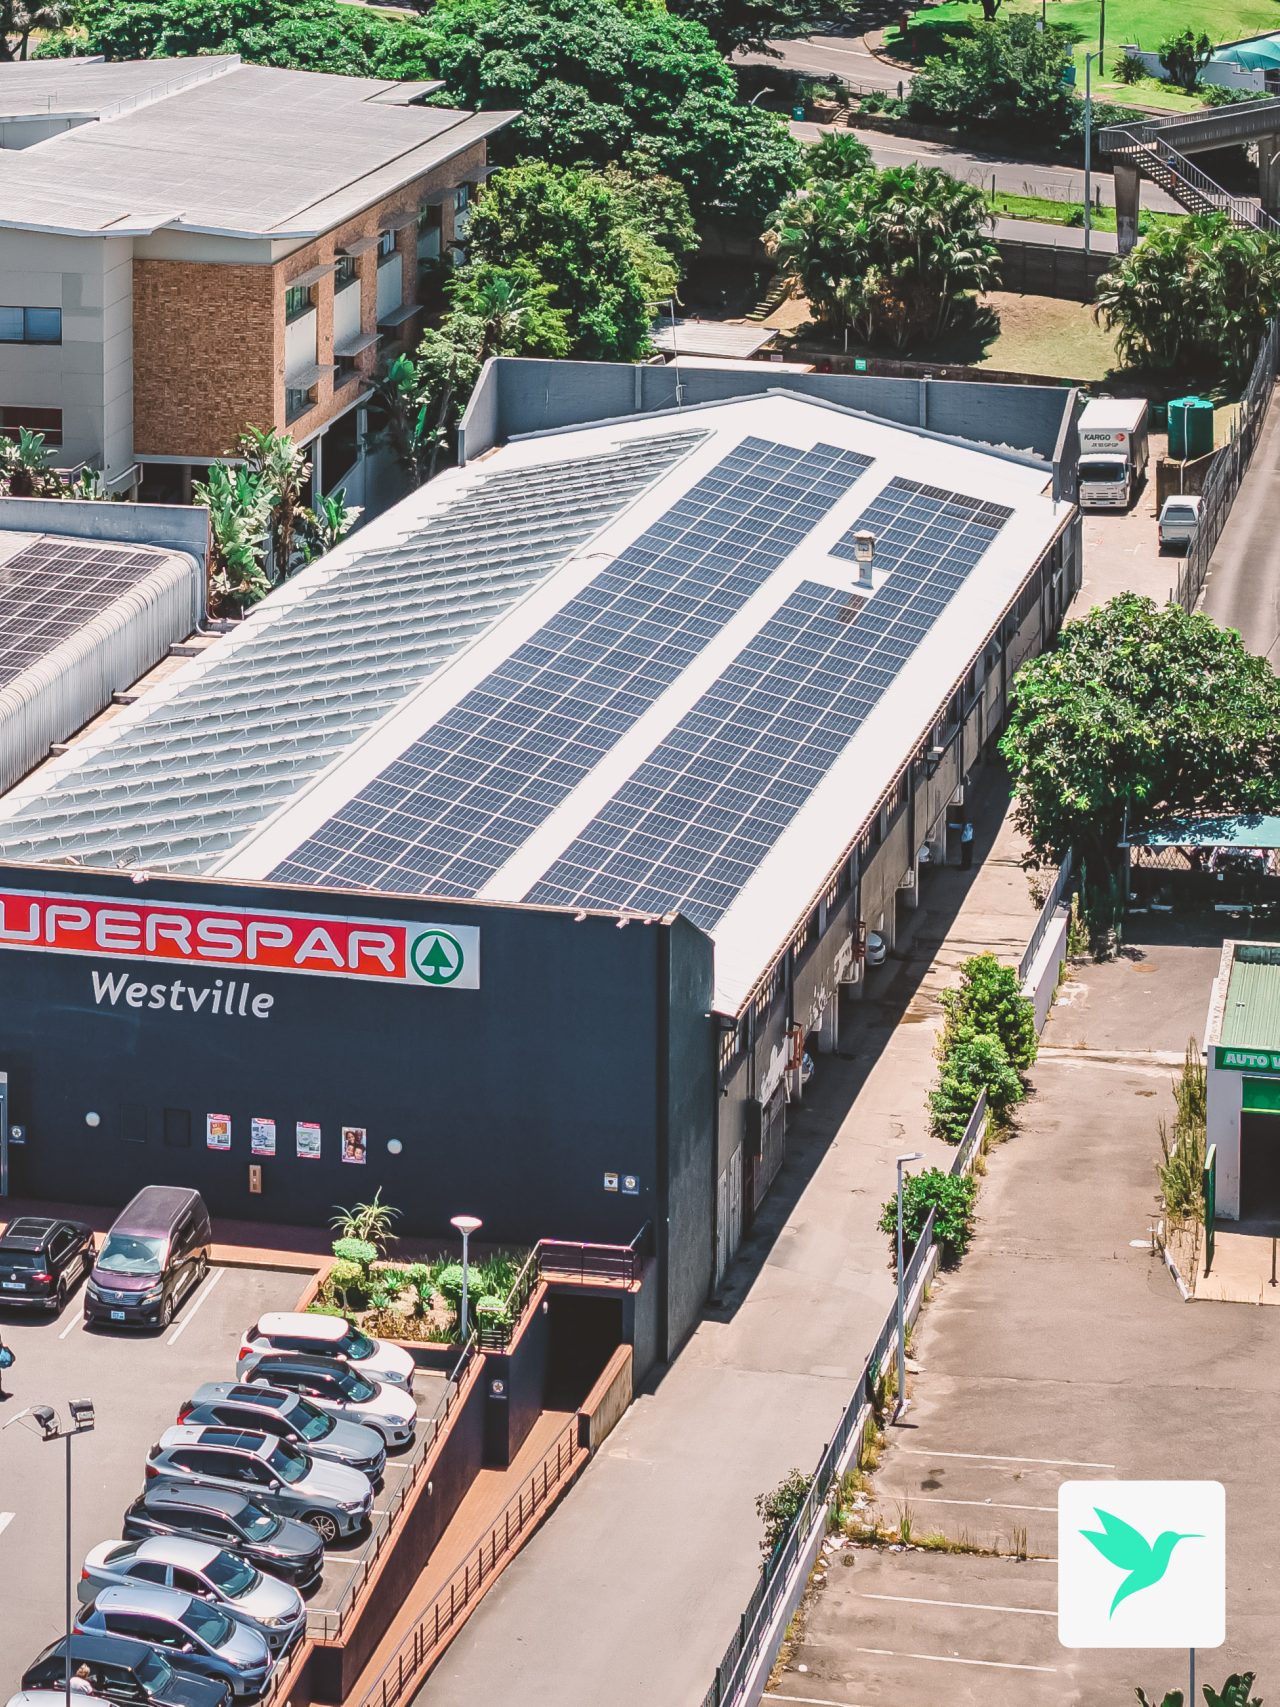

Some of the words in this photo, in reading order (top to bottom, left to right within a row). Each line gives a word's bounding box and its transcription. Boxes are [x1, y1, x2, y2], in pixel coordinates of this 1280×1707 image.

[1084, 433, 1111, 441] KARGO
[91, 970, 275, 1019] Westville
[1225, 1053, 1268, 1066] AUTO
